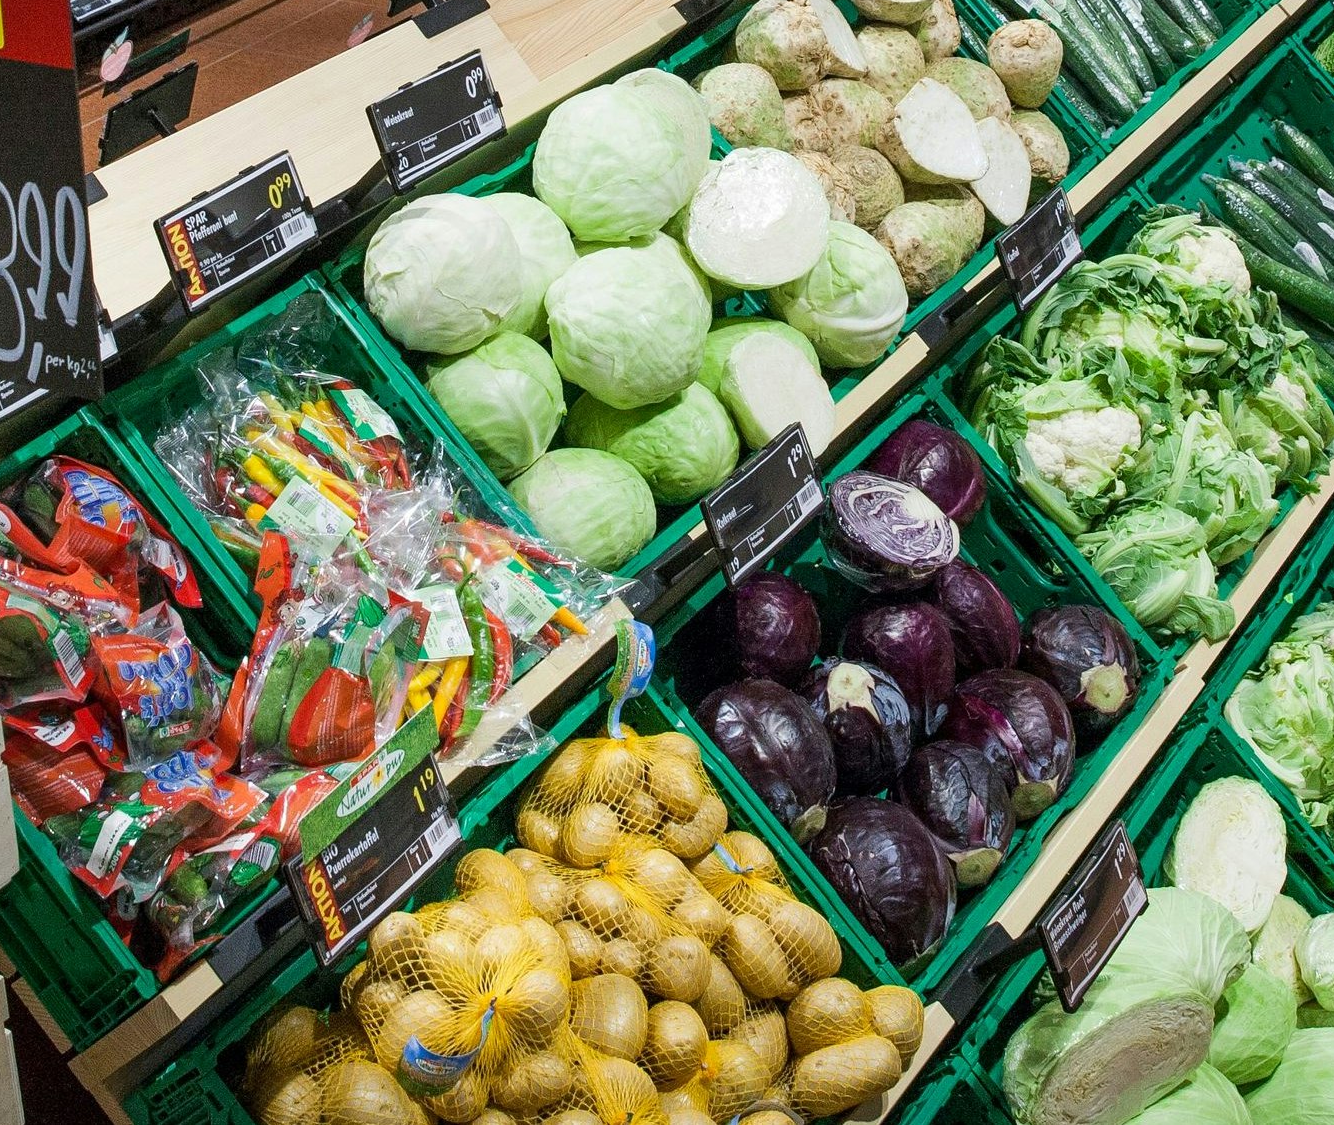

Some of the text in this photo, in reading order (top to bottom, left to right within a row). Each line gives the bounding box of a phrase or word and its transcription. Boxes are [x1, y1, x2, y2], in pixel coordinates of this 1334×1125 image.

[383, 107, 415, 130] Weisskraut
[184, 209, 209, 232] SPAR
[167, 221, 205, 298] AKTION
[45, 355, 65, 374] per
[338, 753, 404, 814] Natur pur
[321, 843, 340, 863] BIO
[304, 863, 345, 942] AKTION
